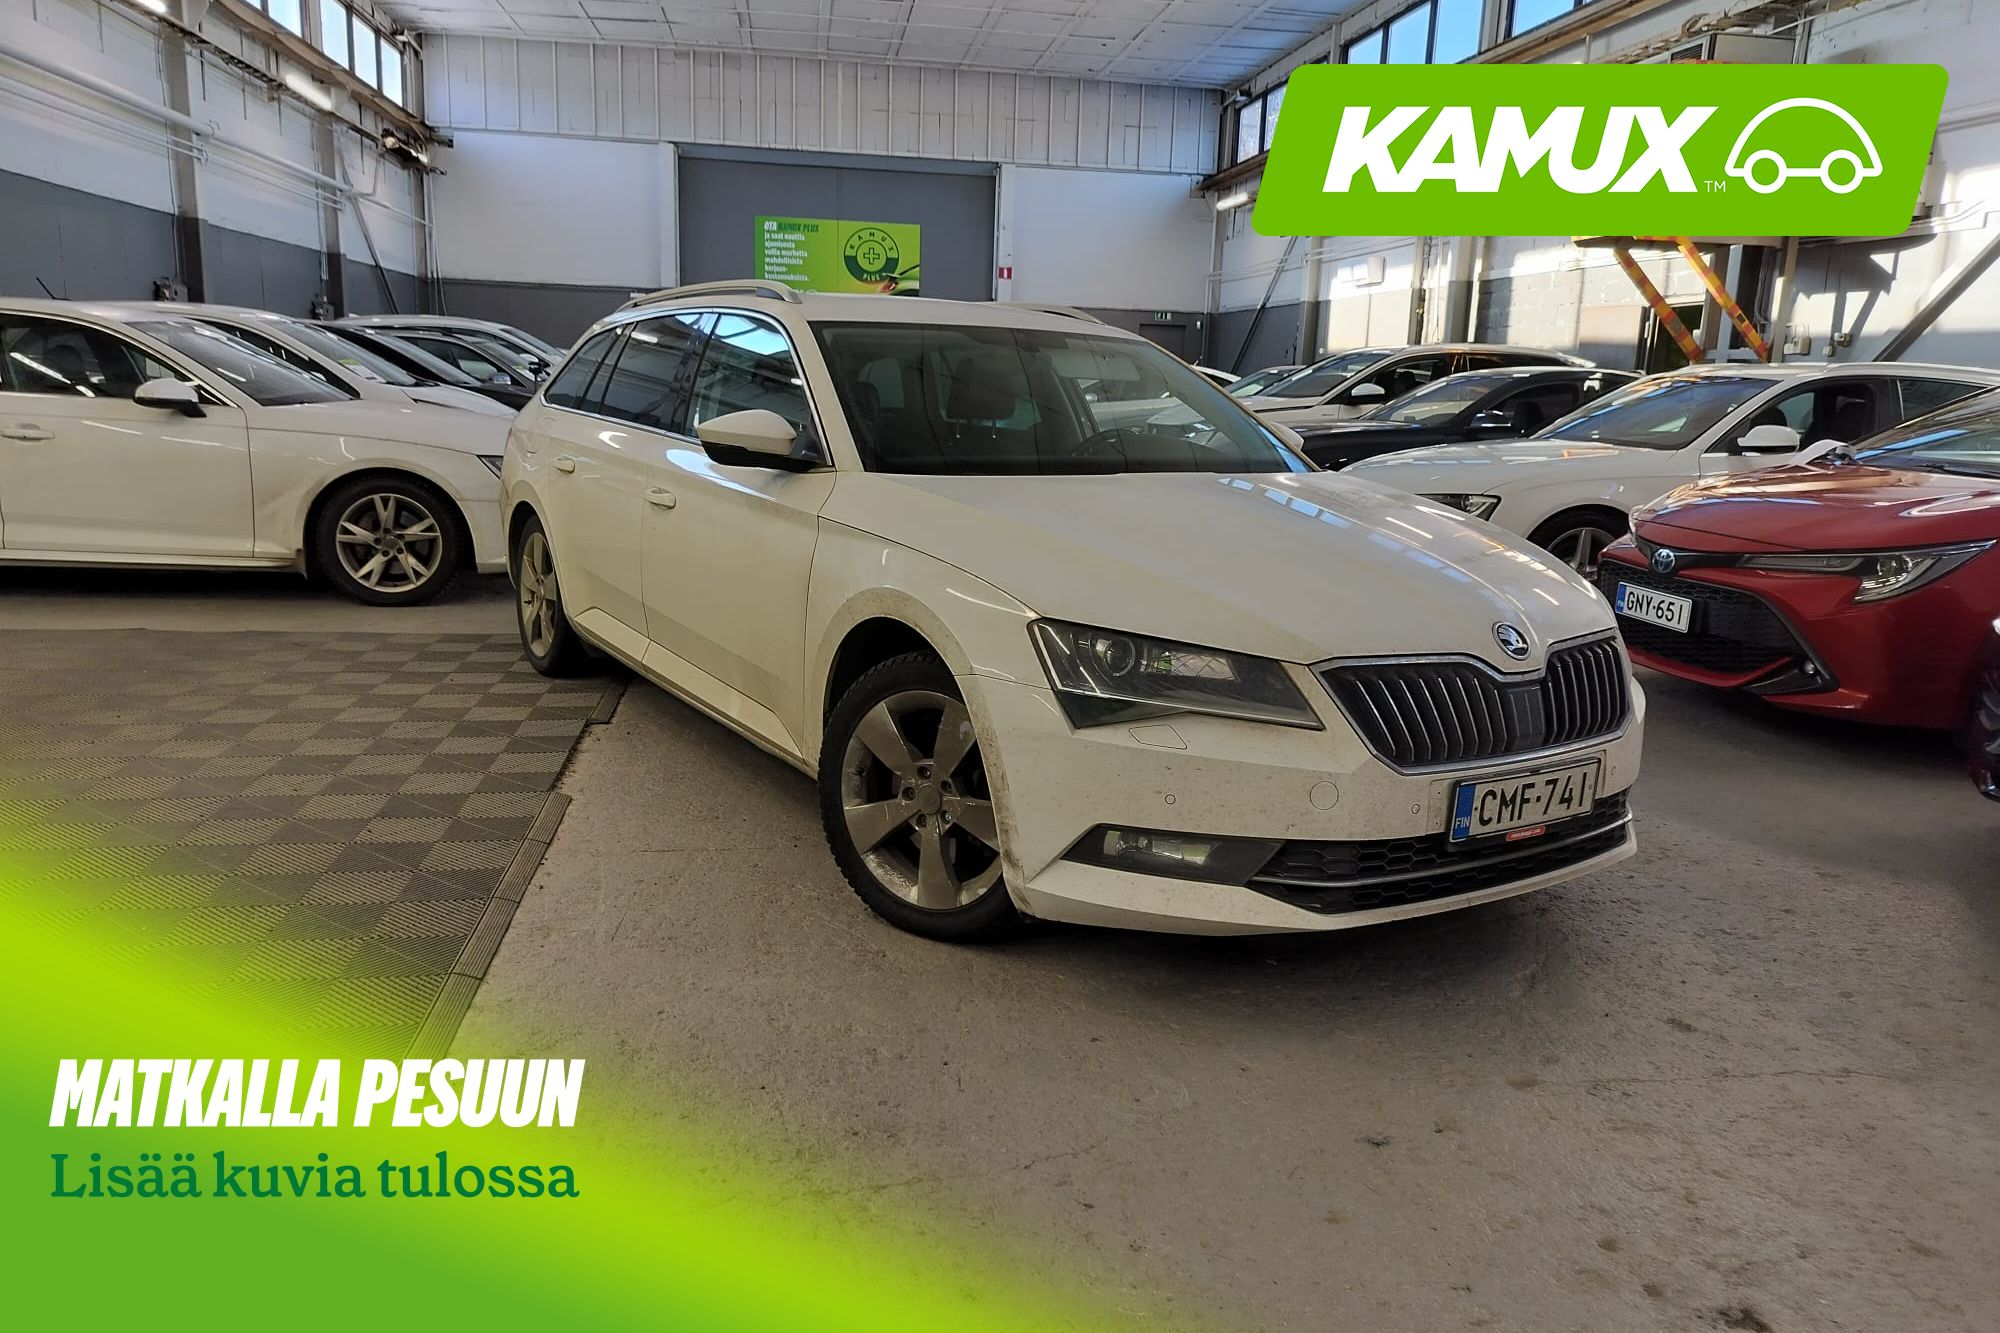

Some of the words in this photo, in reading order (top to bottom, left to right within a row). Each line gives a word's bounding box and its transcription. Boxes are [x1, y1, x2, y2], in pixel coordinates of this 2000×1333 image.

[802, 223, 820, 233] PLUS
[1626, 591, 1683, 625] GNY-651
[1479, 771, 1587, 827] CMF-741
[1455, 816, 1471, 830] FIN
